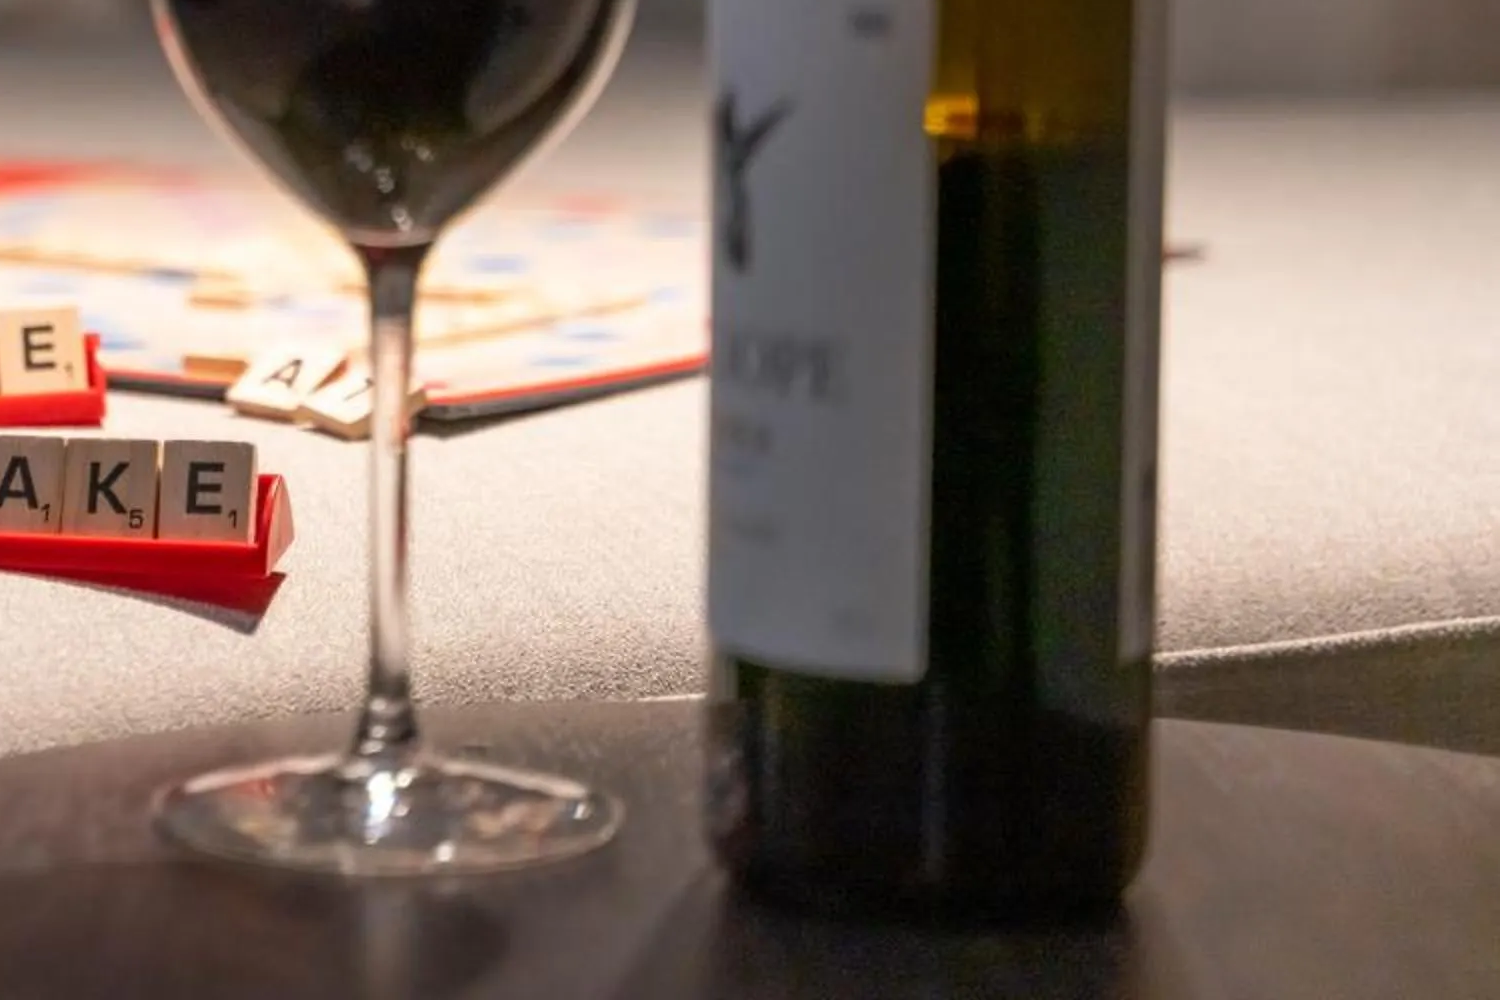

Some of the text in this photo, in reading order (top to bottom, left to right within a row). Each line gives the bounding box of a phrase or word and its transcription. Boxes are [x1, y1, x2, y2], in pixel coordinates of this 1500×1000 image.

[263, 358, 303, 388] A
[41, 503, 51, 523] 1
[128, 509, 144, 530] 5
[228, 510, 237, 529] 1
